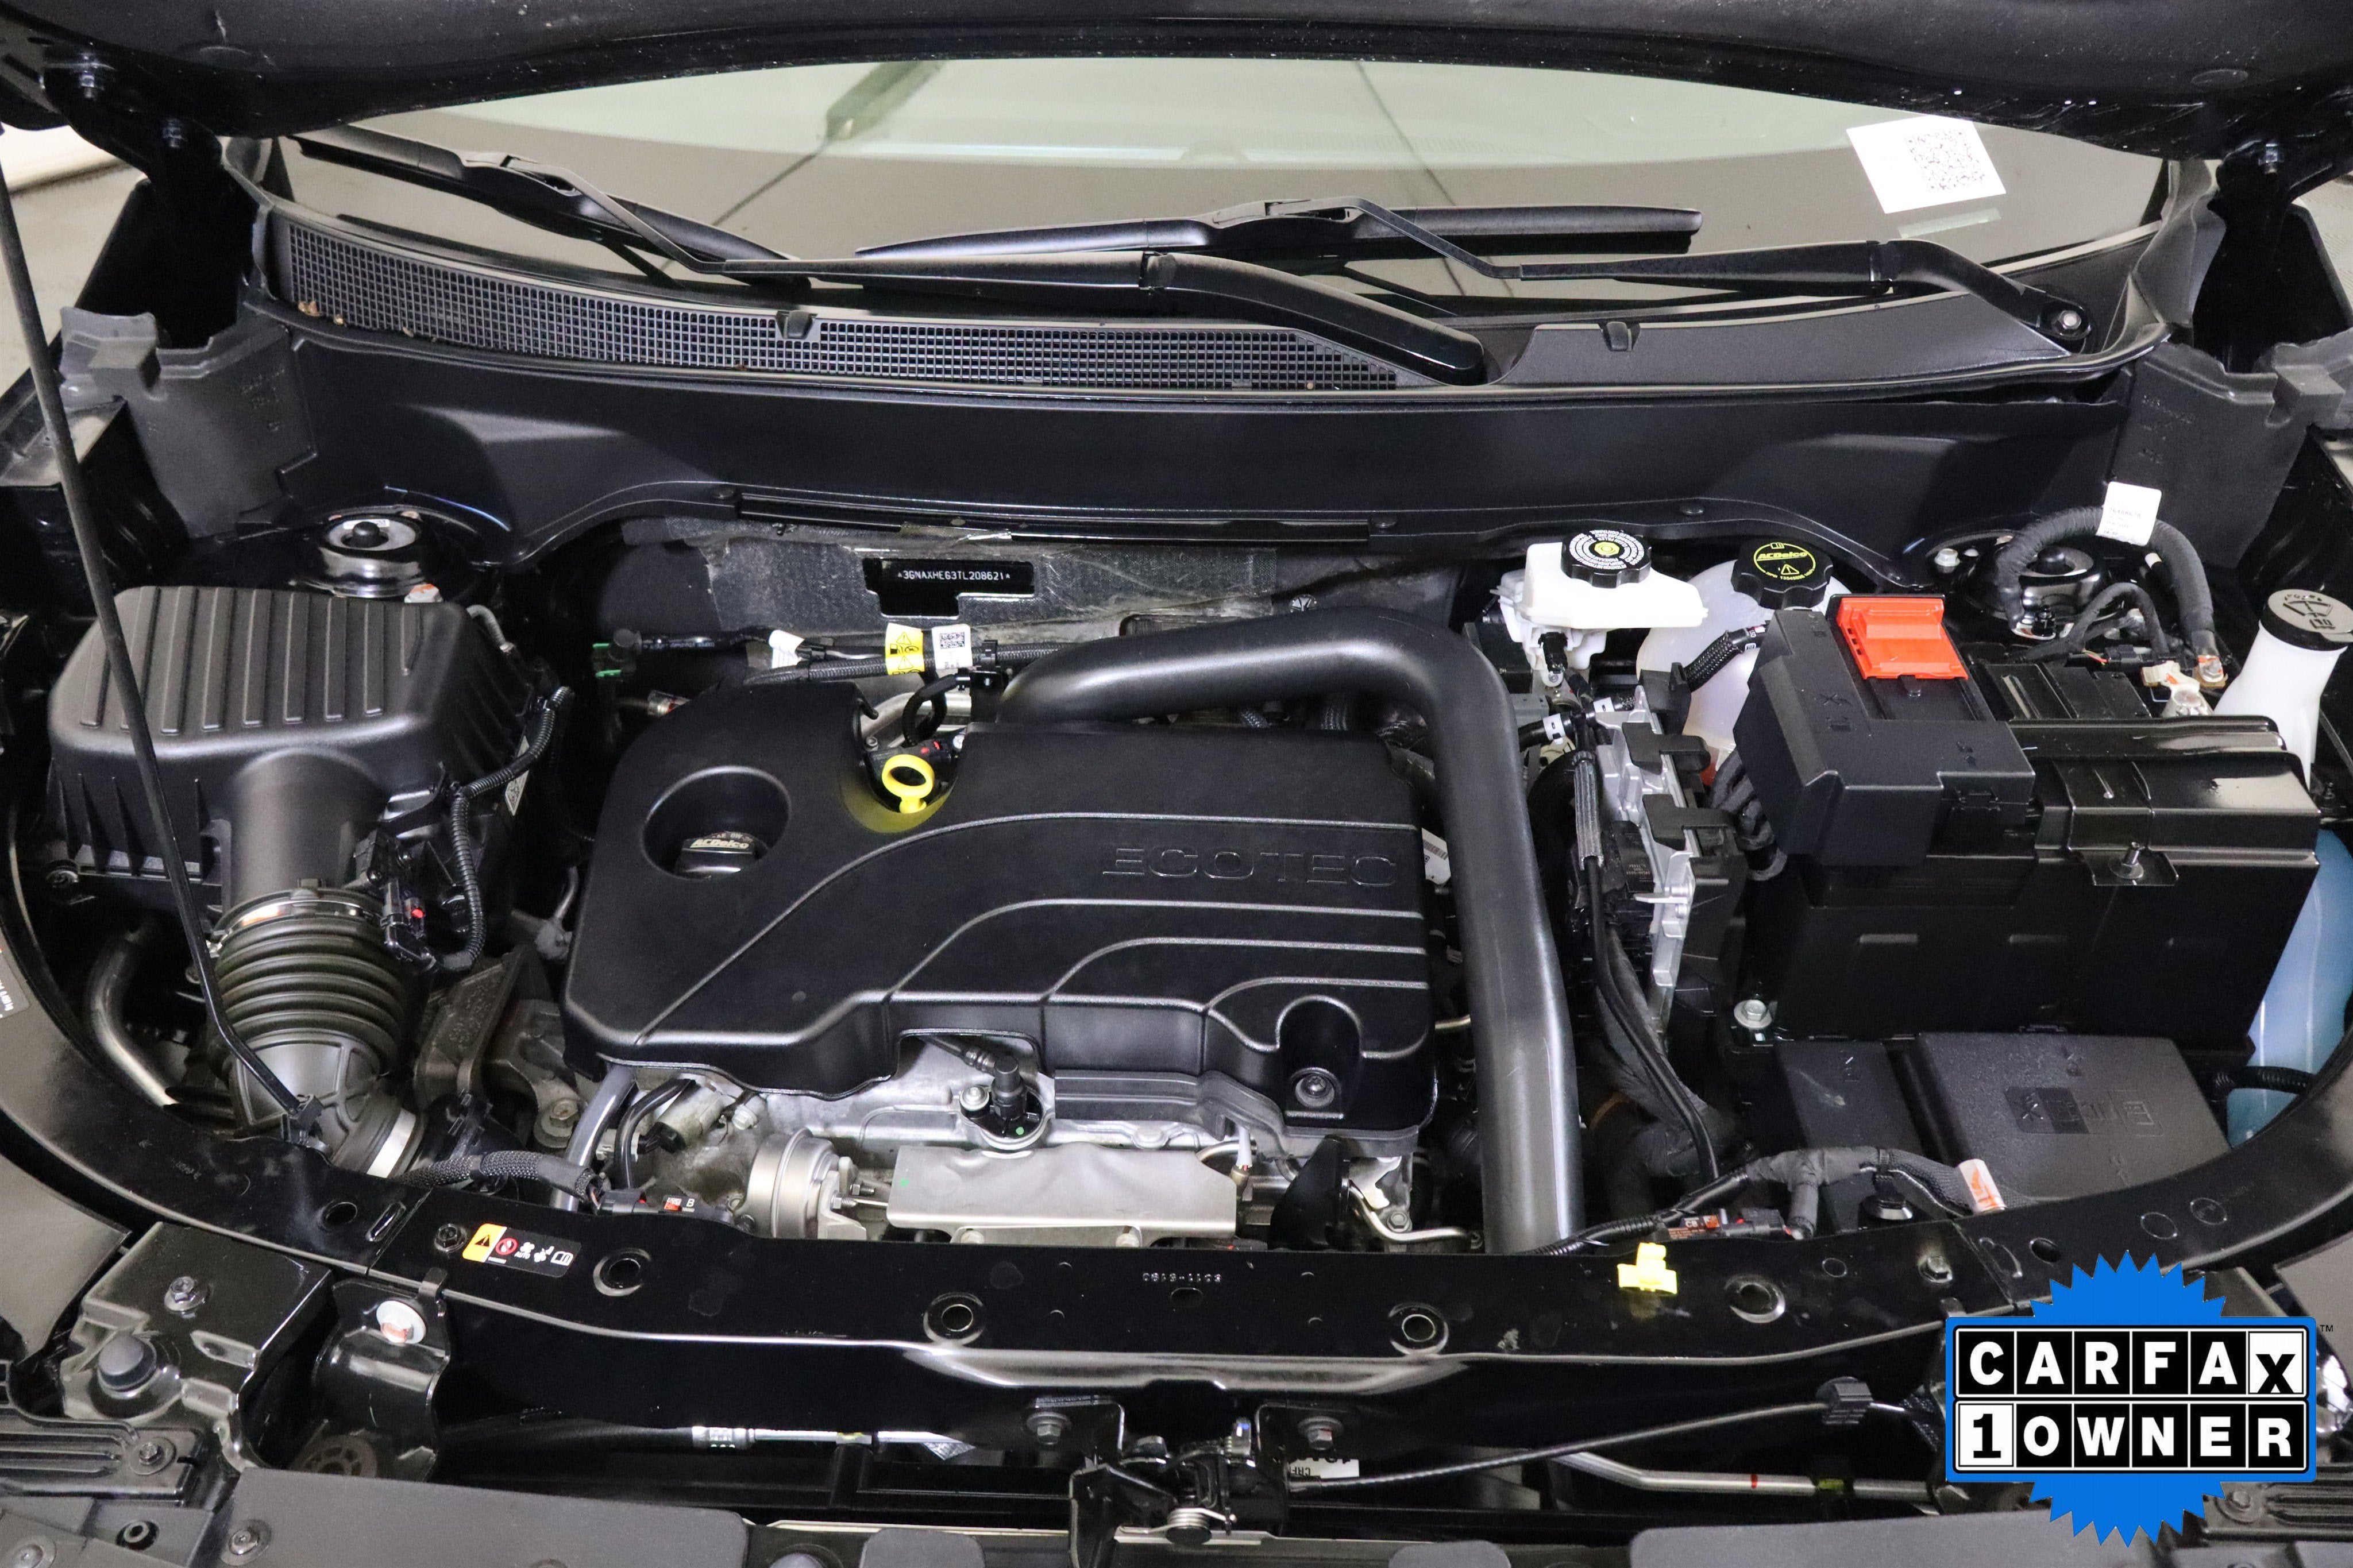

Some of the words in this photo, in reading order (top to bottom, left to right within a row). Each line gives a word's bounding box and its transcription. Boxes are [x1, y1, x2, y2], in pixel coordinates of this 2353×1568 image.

[1757, 552, 1808, 561] ACDelco
[690, 839, 749, 849] ACDelco
[1102, 848, 1397, 887] ECOTEC
[514, 1251, 531, 1260] AUTO
